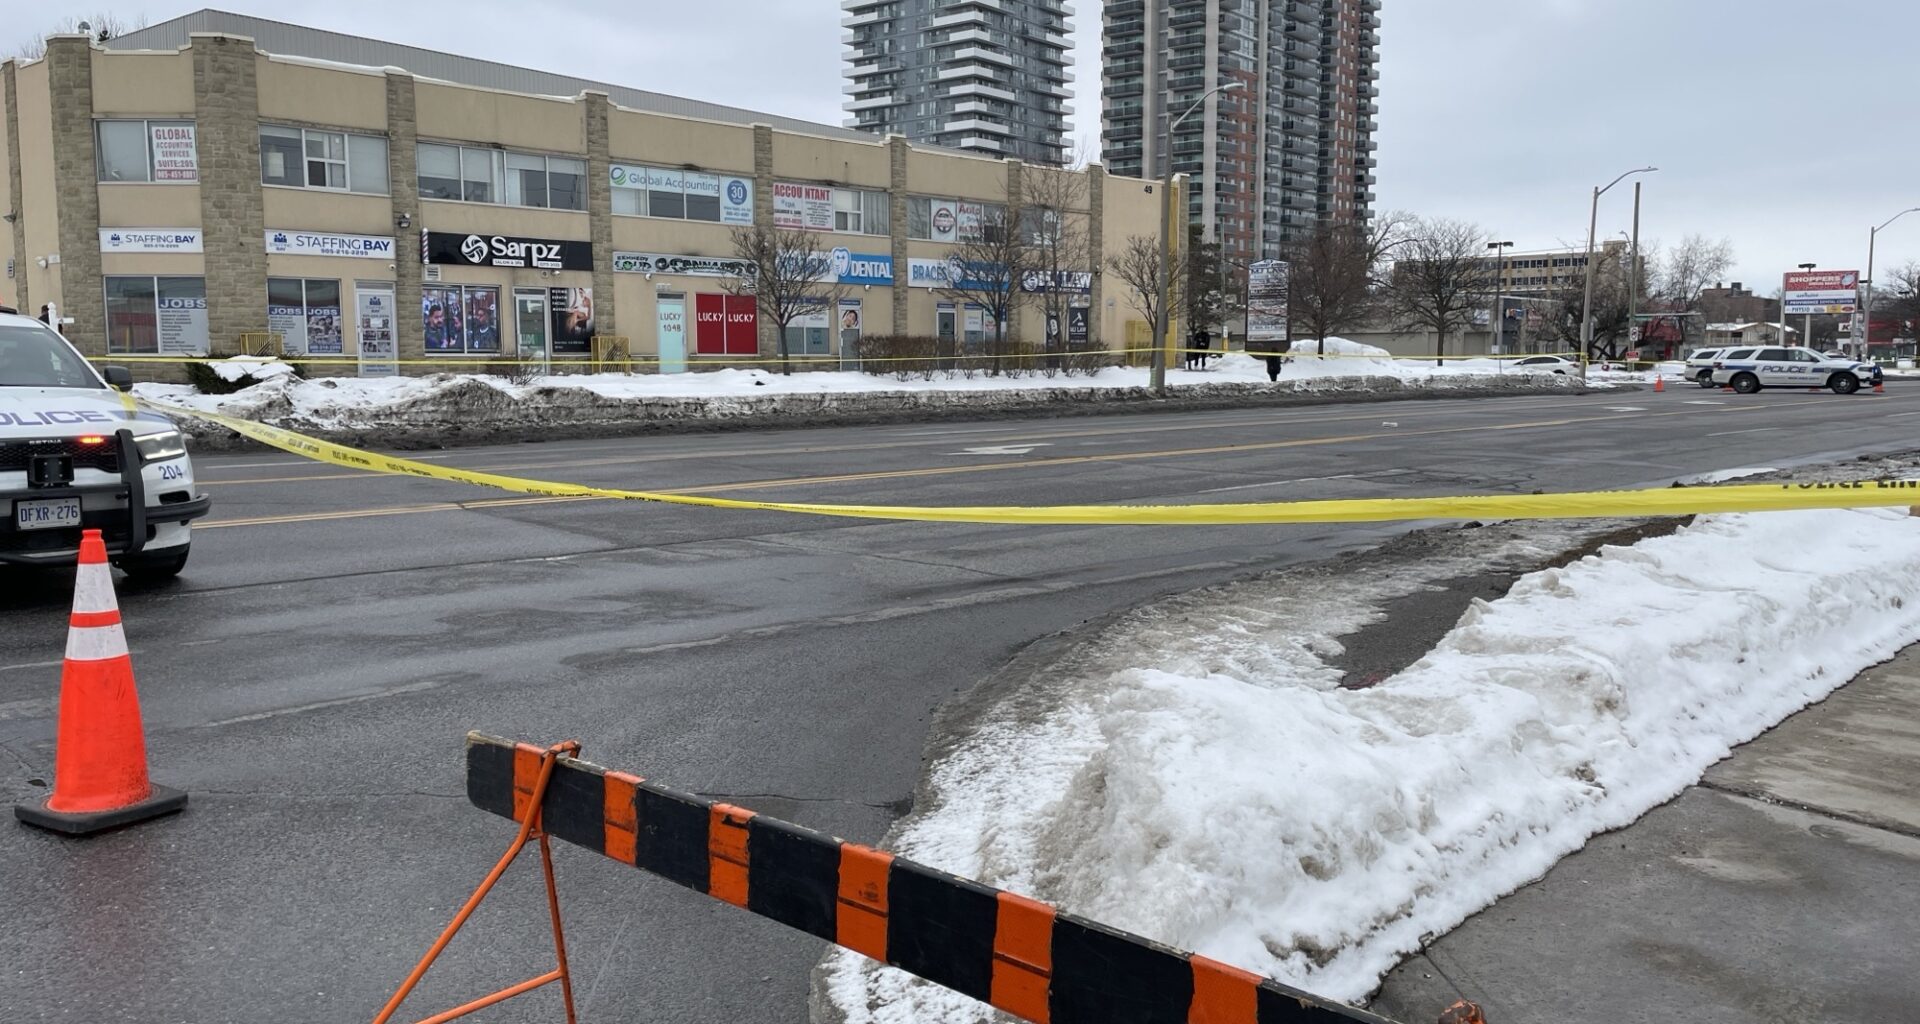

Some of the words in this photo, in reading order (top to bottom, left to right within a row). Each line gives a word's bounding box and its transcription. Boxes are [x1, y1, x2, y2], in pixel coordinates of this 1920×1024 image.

[155, 128, 192, 140] GLOBAL
[629, 173, 663, 186] Global
[665, 176, 720, 194] Accounting
[731, 186, 743, 199] 30
[125, 234, 174, 243] STAFFING
[175, 235, 195, 243] BAY
[296, 235, 361, 250] STAFFING
[363, 240, 391, 251] BAY
[490, 236, 562, 267] Sarpz
[851, 260, 894, 278] DENTAL
[912, 264, 949, 281] BRACES
[160, 299, 206, 309] JOBS
[660, 312, 682, 321] LUCKY
[698, 313, 724, 322] LUCKY
[728, 314, 754, 323] LUCKY
[1761, 365, 1808, 373] POLICE
[159, 465, 183, 480] 204
[1877, 480, 1920, 489] LIN
